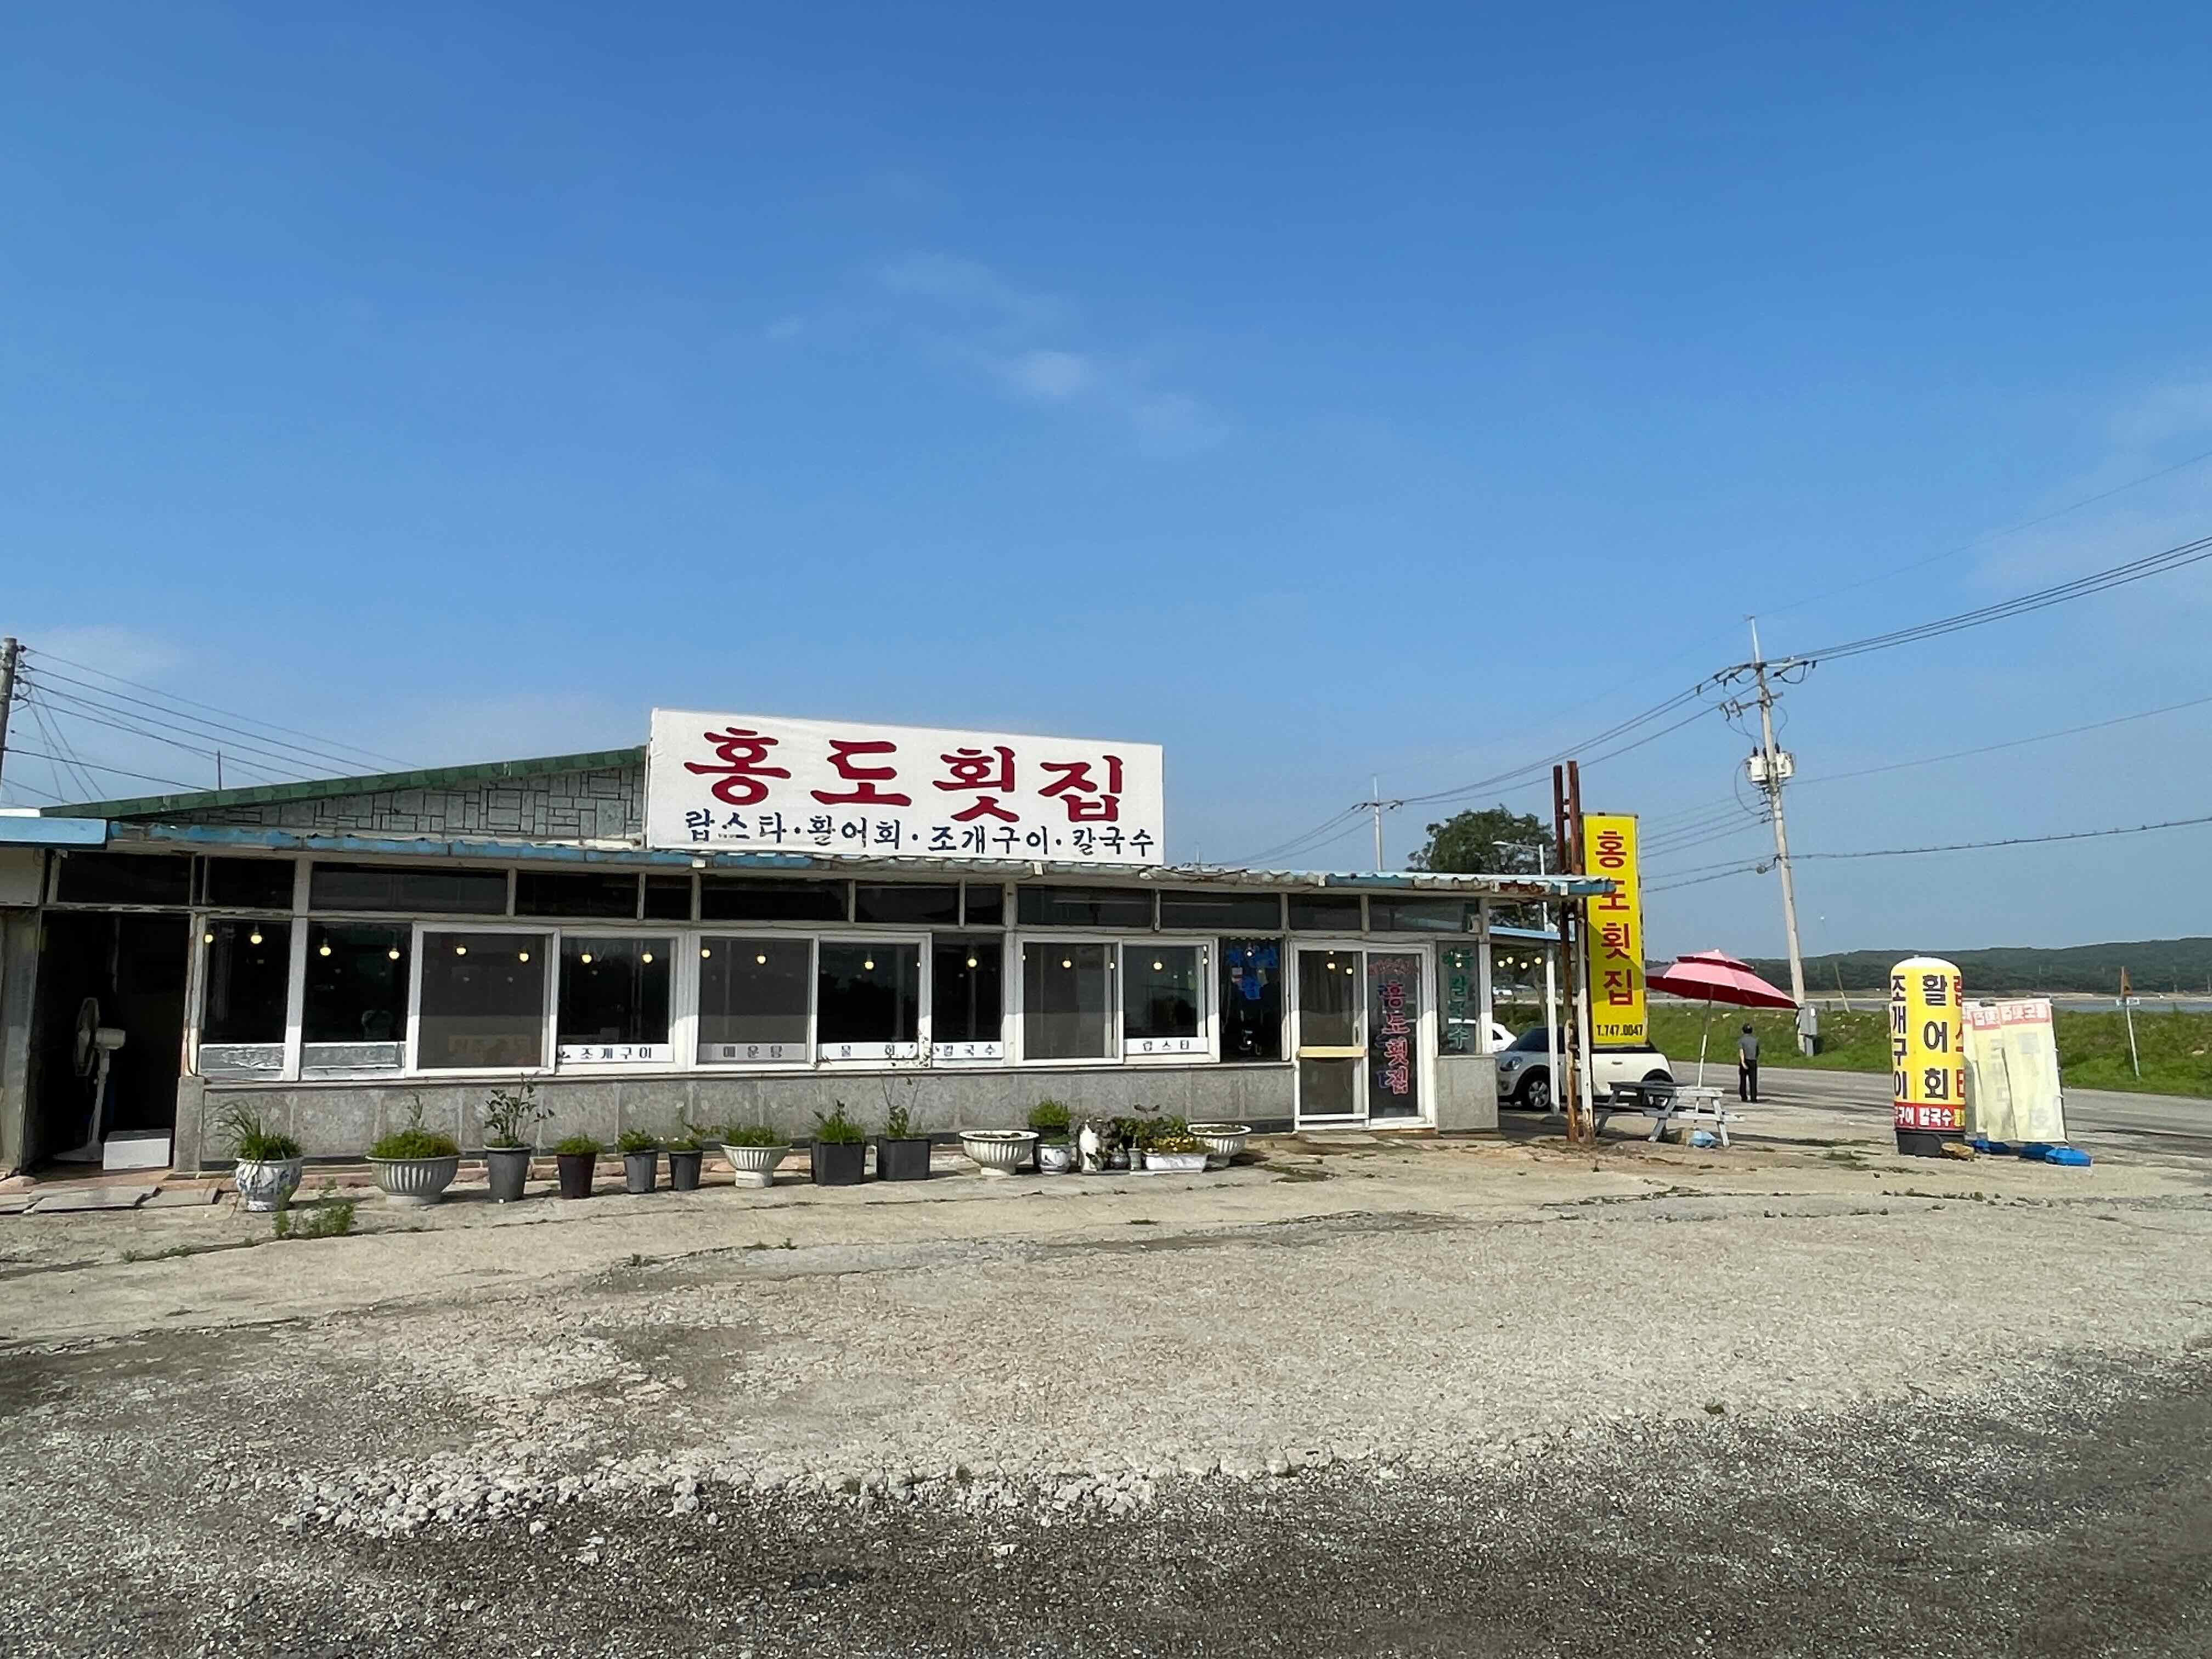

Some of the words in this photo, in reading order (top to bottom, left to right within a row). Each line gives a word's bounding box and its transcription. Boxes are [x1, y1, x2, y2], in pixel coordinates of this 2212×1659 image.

[684, 727, 1123, 822] 홍도횟집
[927, 825, 1048, 855] 조개구이
[1072, 826, 1155, 857] 칼국수
[1922, 974, 1949, 1101] 활어회
